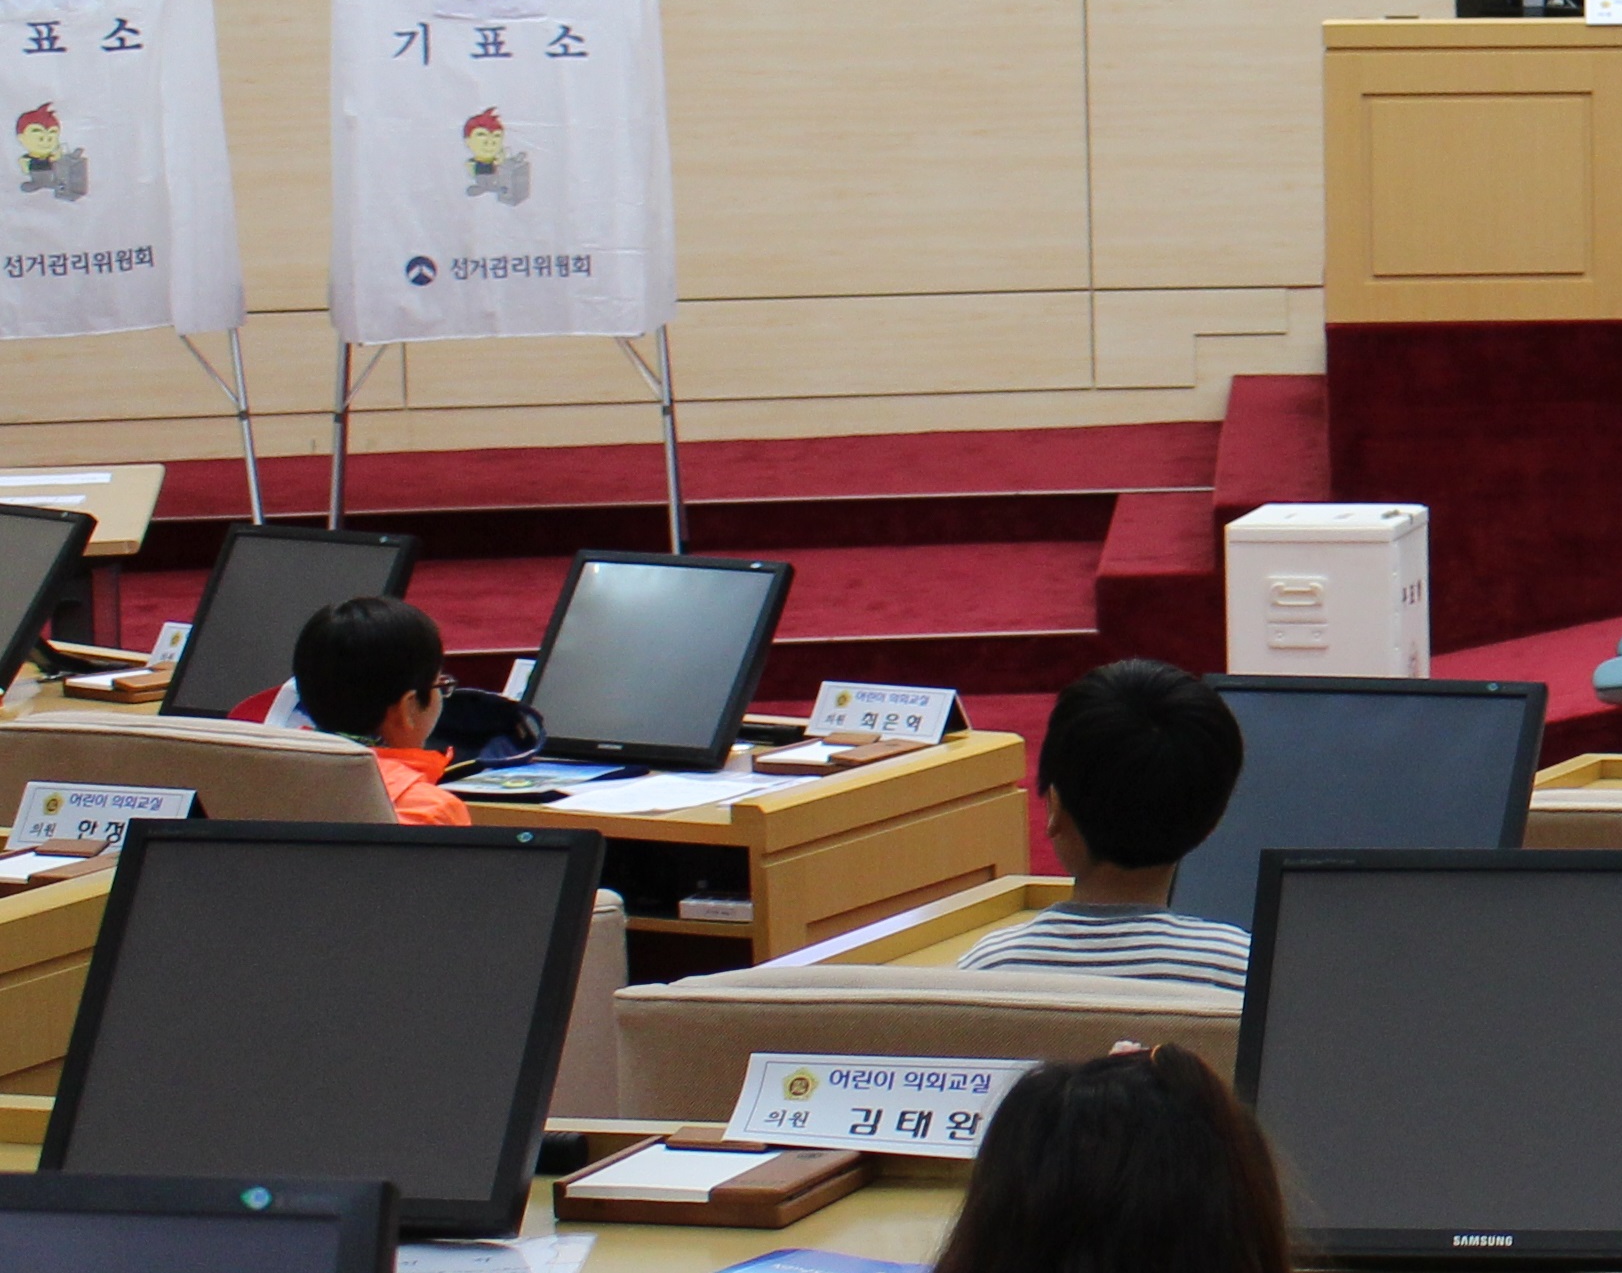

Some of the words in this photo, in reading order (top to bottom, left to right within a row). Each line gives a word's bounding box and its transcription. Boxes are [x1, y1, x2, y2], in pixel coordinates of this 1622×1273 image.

[3, 245, 155, 279] 선거관리위원회
[450, 254, 592, 281] 선거관리위원회
[69, 793, 109, 808] 어린이
[29, 822, 57, 837] 의원
[78, 819, 126, 844] 안정
[829, 1069, 895, 1090] 어린이
[764, 1109, 810, 1128] 의원
[849, 1107, 984, 1141] 김태완
[1453, 1235, 1513, 1247] SAMSUNG
